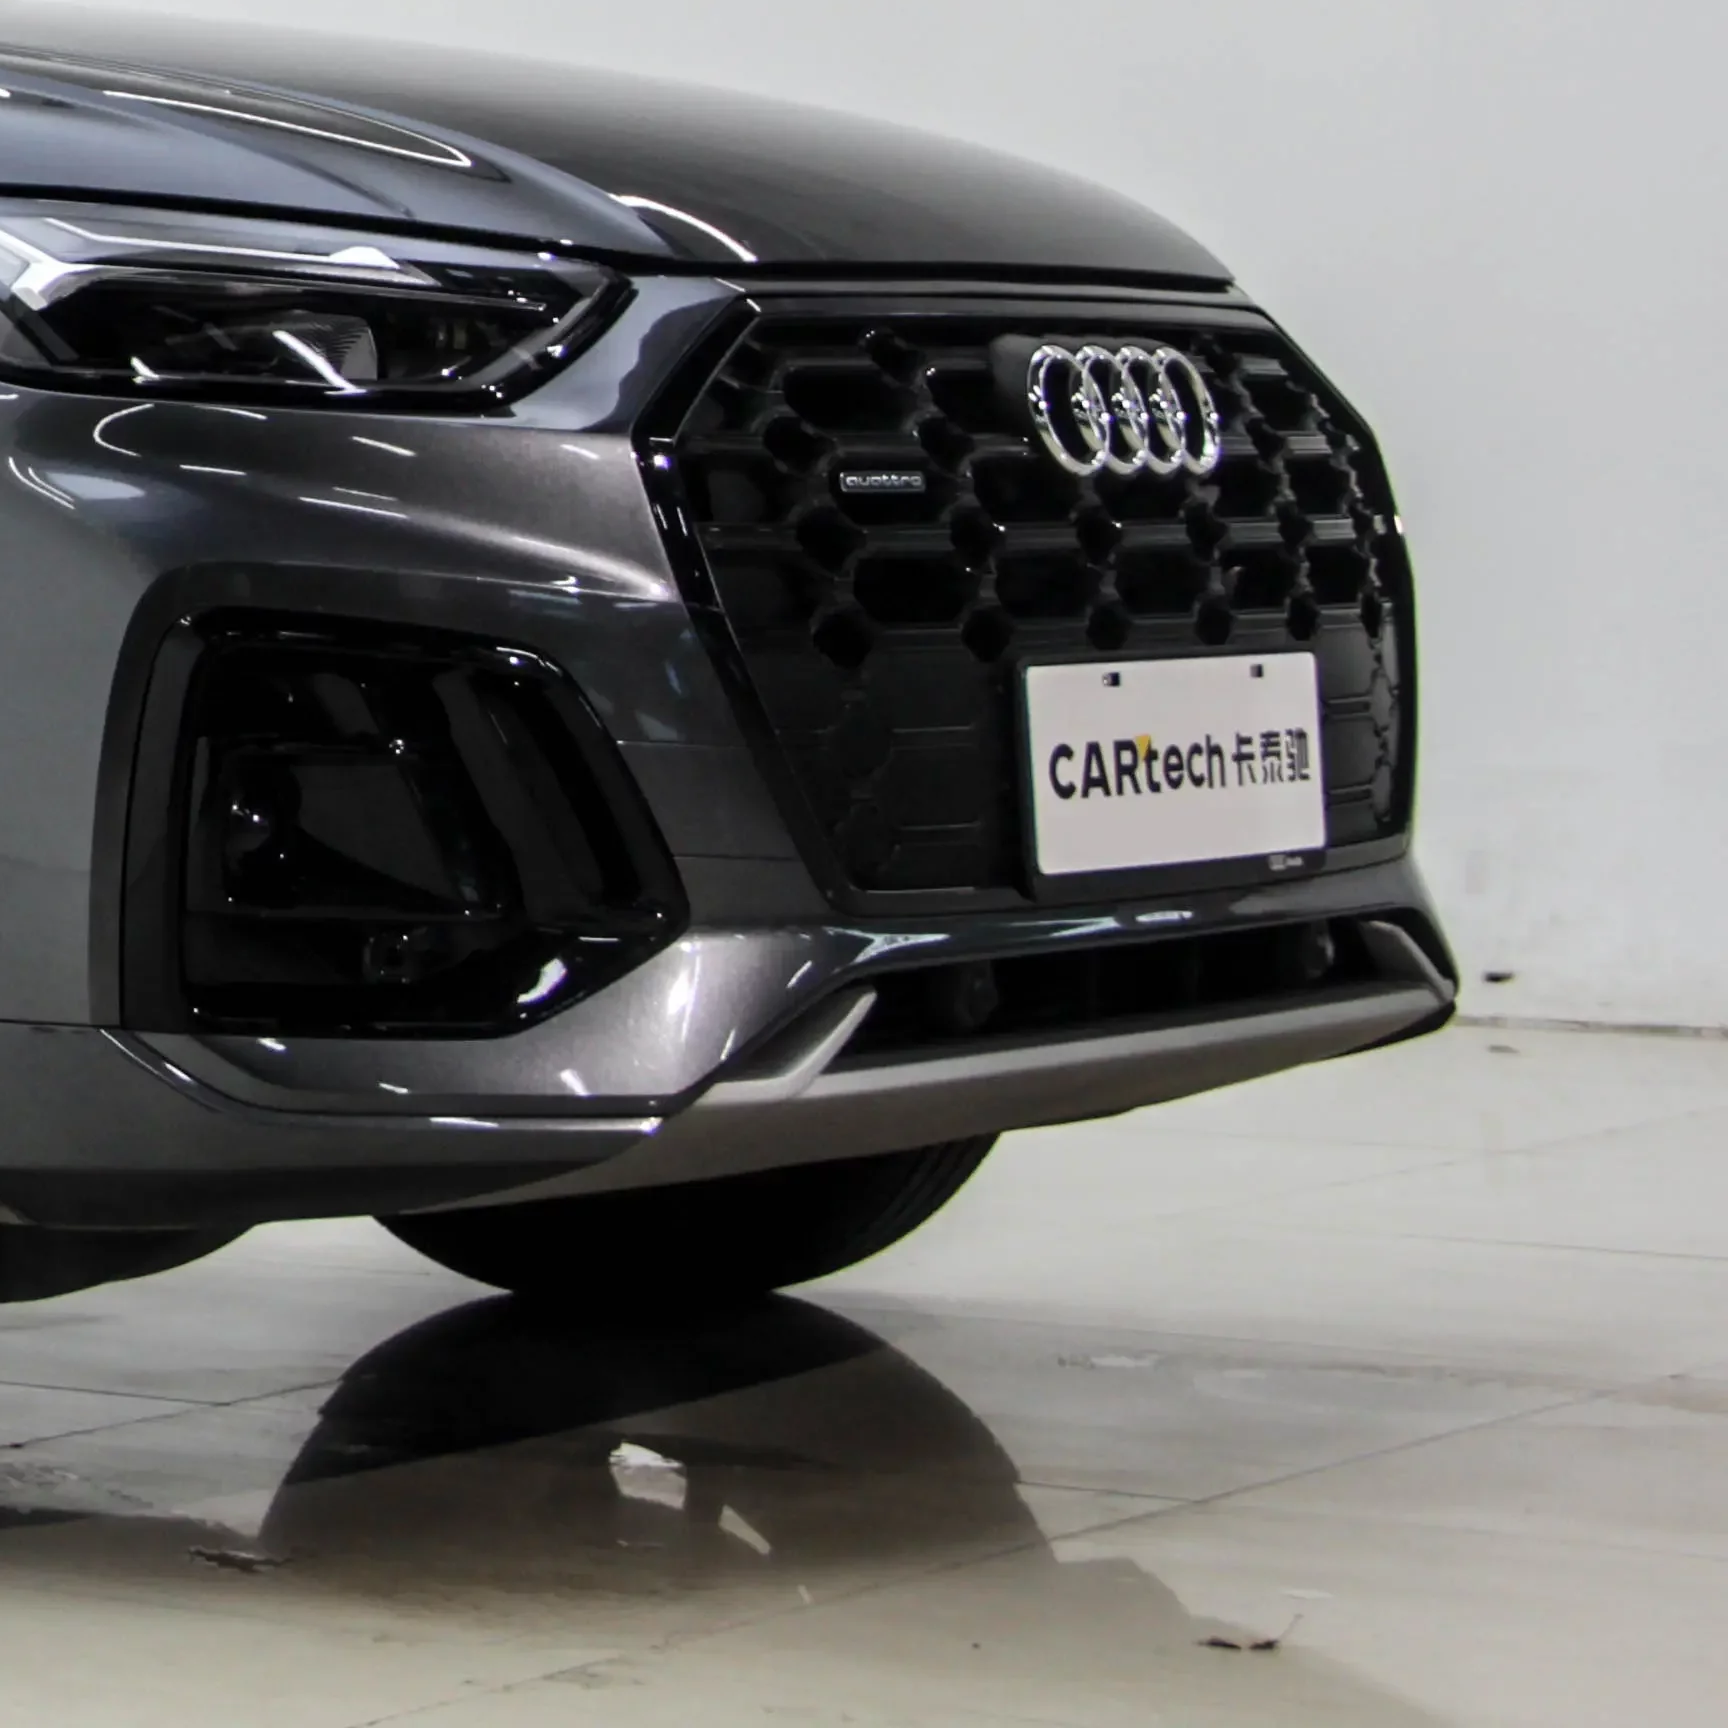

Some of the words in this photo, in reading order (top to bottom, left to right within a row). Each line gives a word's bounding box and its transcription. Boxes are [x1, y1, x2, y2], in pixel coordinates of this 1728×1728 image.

[1049, 734, 1227, 800] CARtech
[1231, 728, 1311, 787] 卡泰驰
